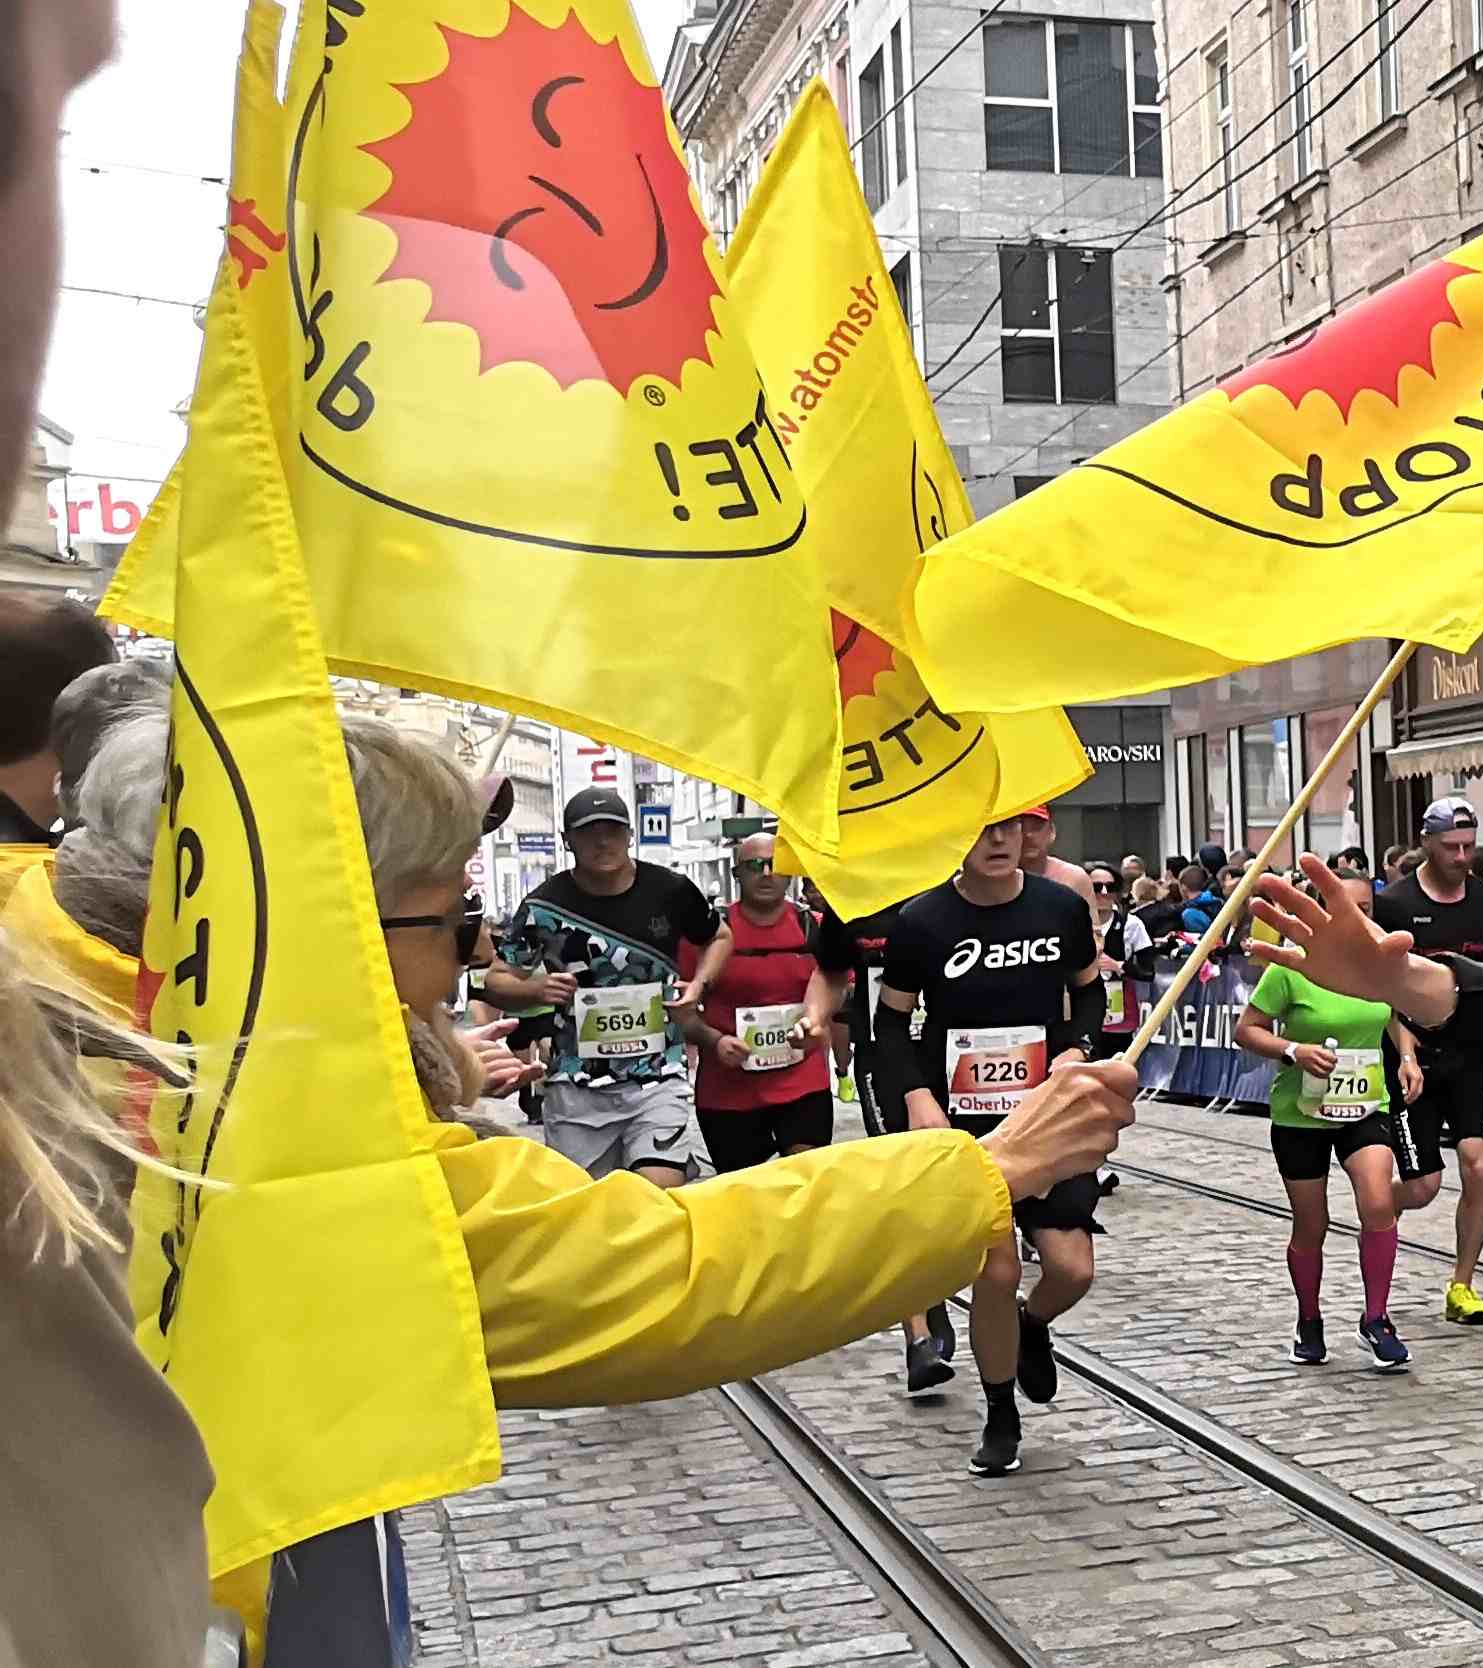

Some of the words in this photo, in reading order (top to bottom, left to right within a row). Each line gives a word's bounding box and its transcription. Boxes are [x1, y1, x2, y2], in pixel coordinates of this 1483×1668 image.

[1083, 744, 1161, 762] AROVSKI
[596, 1011, 647, 1032] 5694
[969, 1060, 1028, 1082] 1226
[1327, 1076, 1369, 1095] 710
